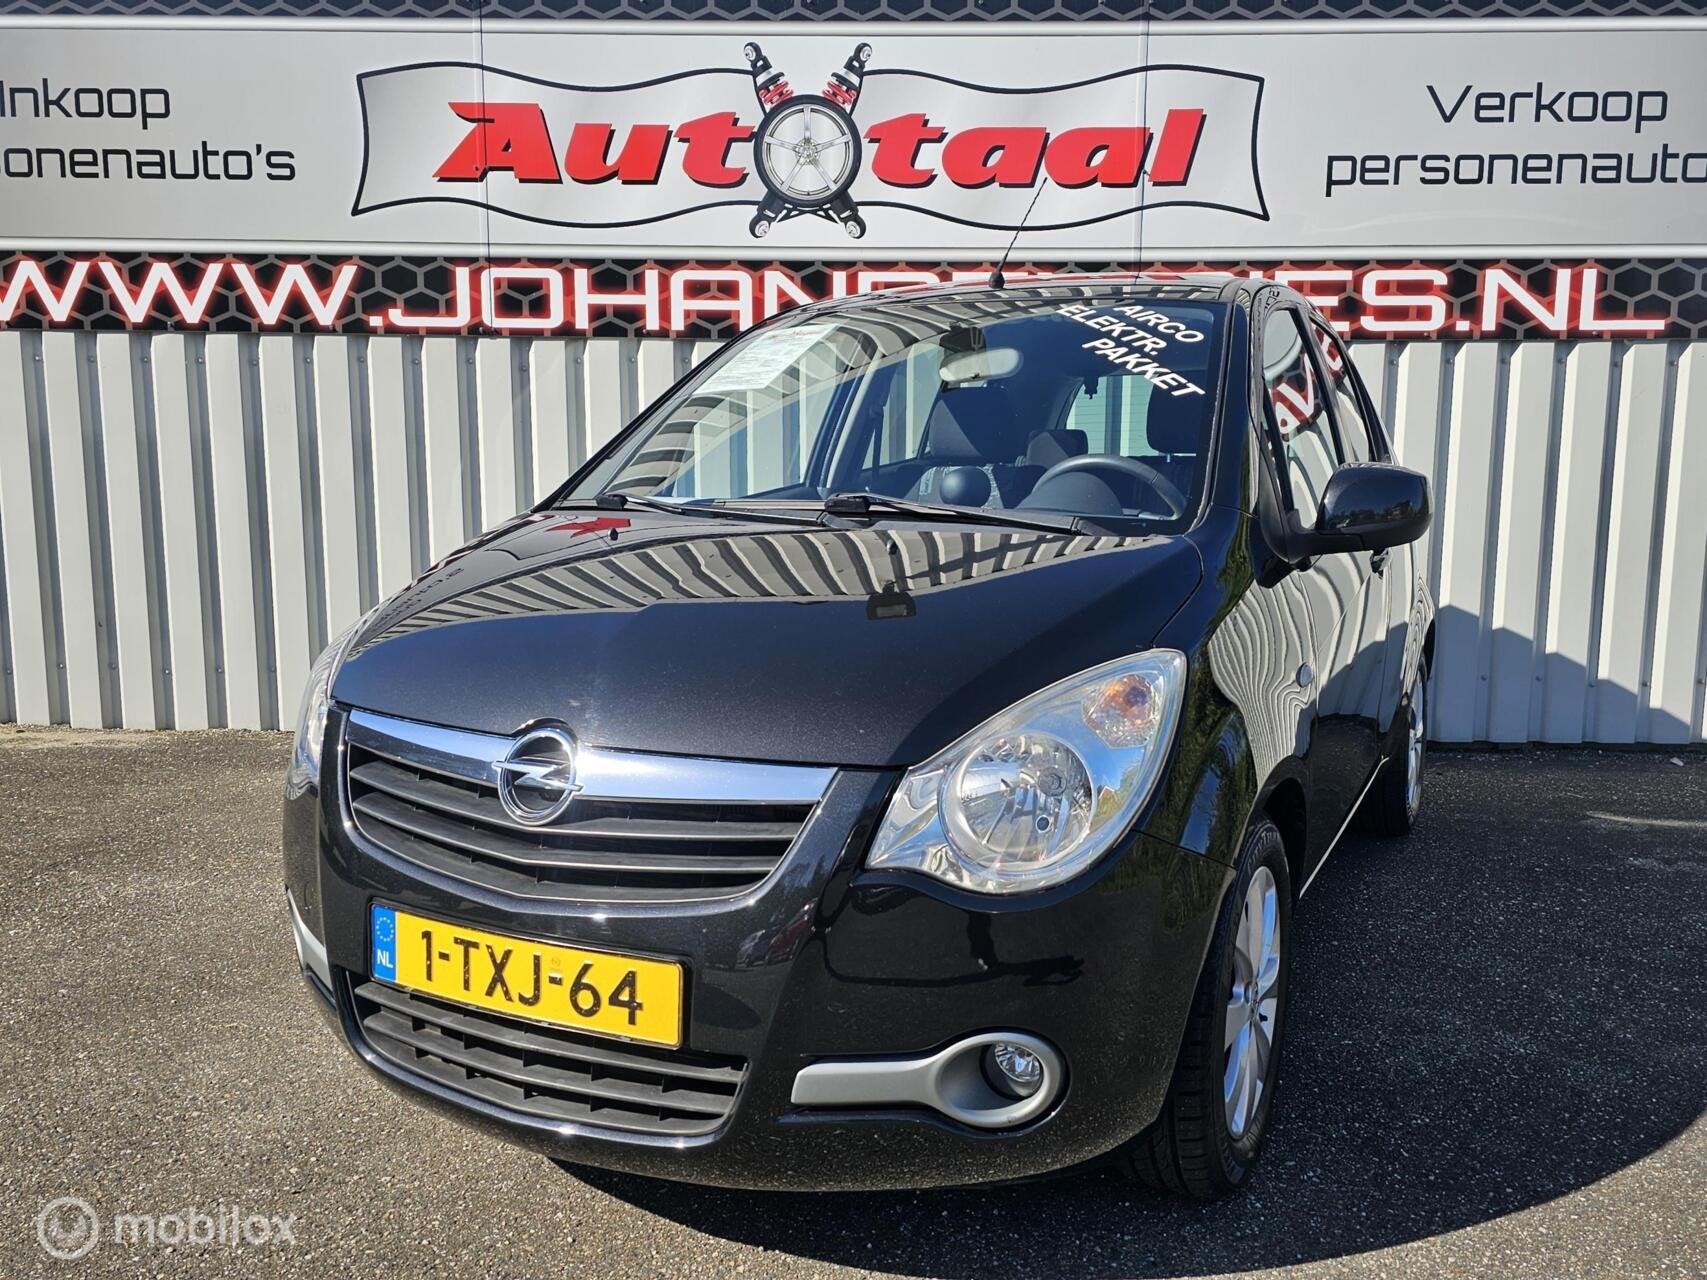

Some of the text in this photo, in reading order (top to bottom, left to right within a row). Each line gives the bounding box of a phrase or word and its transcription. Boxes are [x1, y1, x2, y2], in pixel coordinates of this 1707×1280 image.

[0, 78, 170, 130] Inkoop
[1426, 82, 1668, 134] Verkoop
[0, 141, 296, 181] onenauto's
[1056, 304, 1167, 356] ELEKTR.
[1113, 305, 1205, 343] AIRCO
[1081, 338, 1206, 397] PAKKET
[376, 949, 394, 968] NL
[421, 930, 643, 1026] 1-TXJ-64
